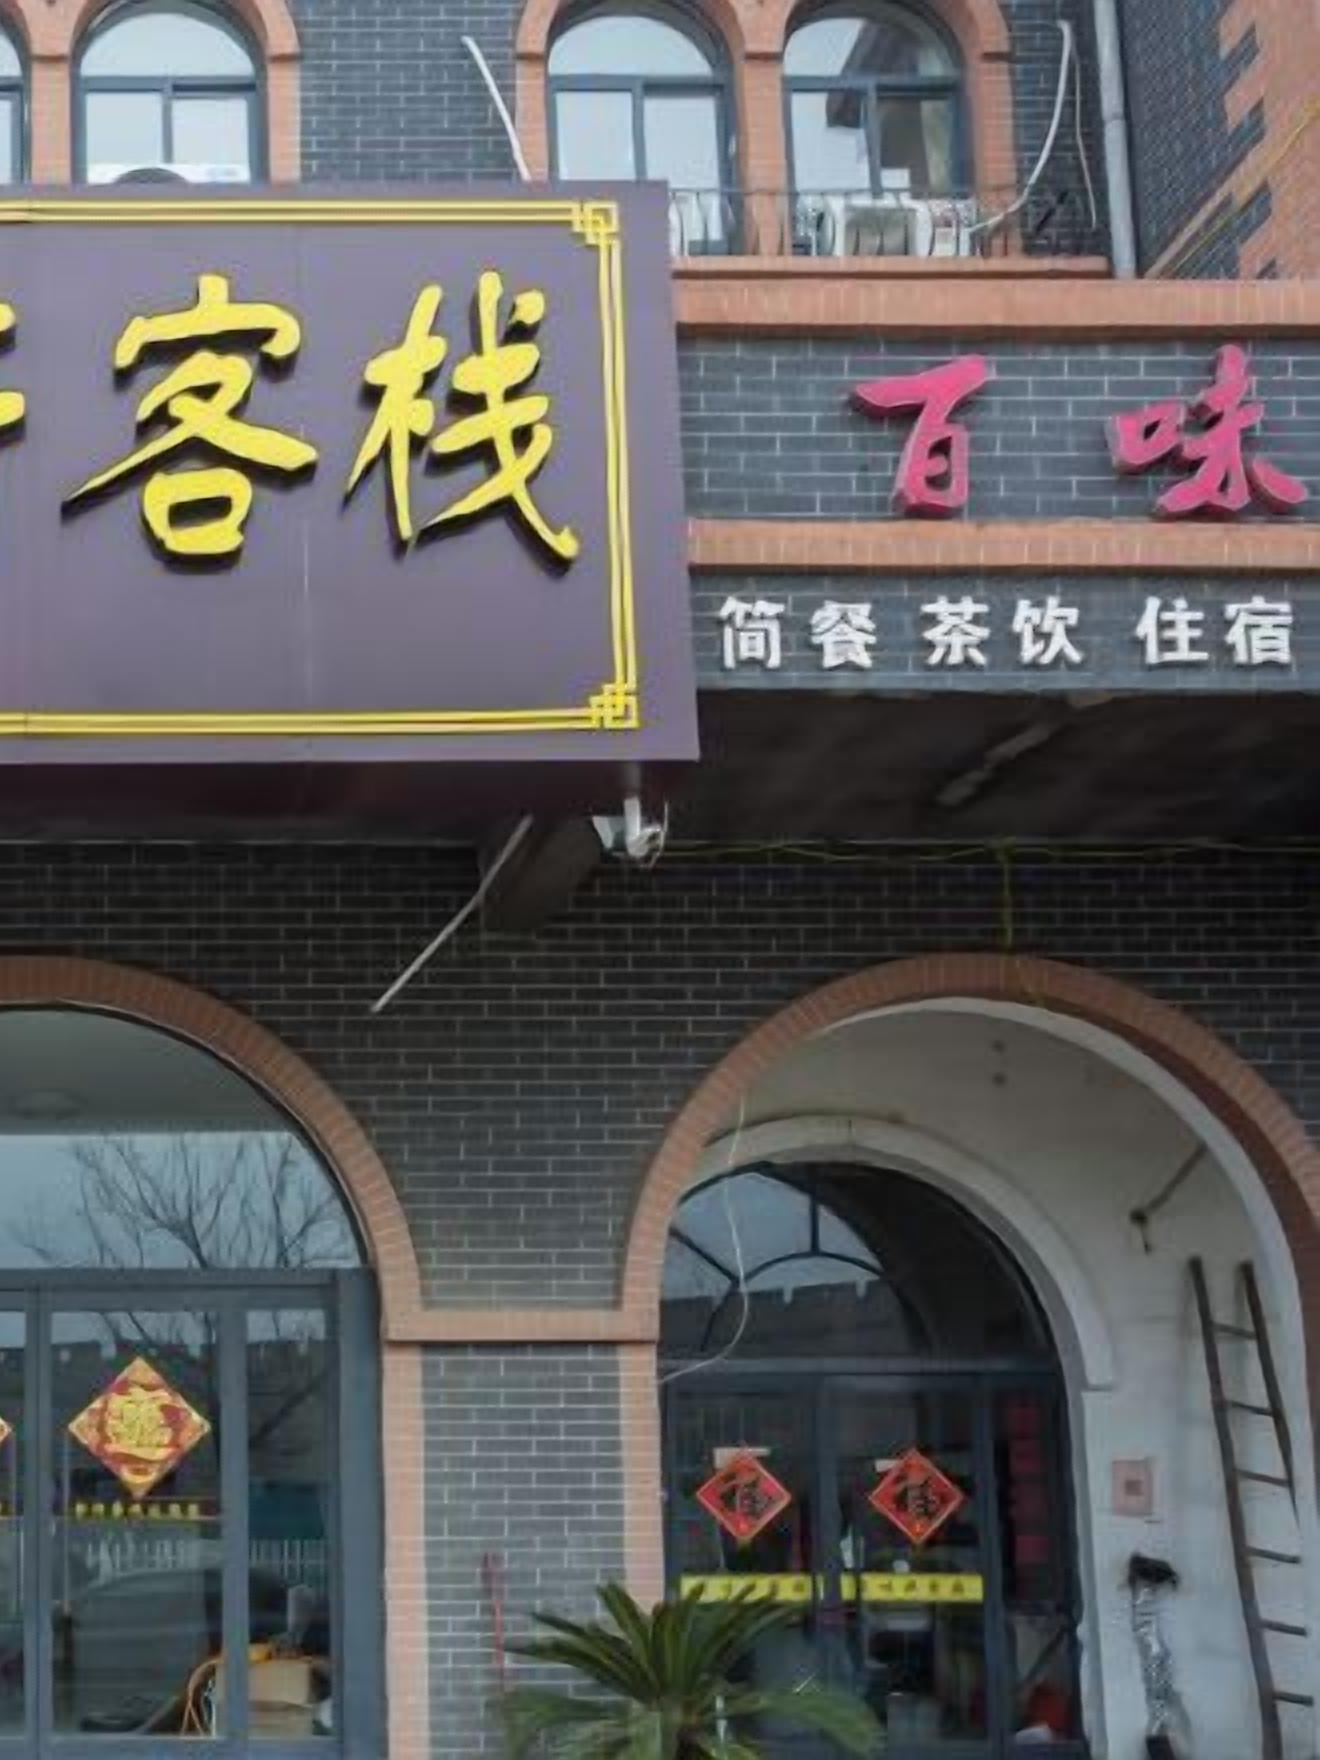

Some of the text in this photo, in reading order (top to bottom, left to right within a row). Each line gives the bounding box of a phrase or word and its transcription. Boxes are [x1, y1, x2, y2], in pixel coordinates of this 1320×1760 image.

[848, 344, 1309, 522] 百味
[718, 596, 1295, 670] 简餐 茶饮 住宿
